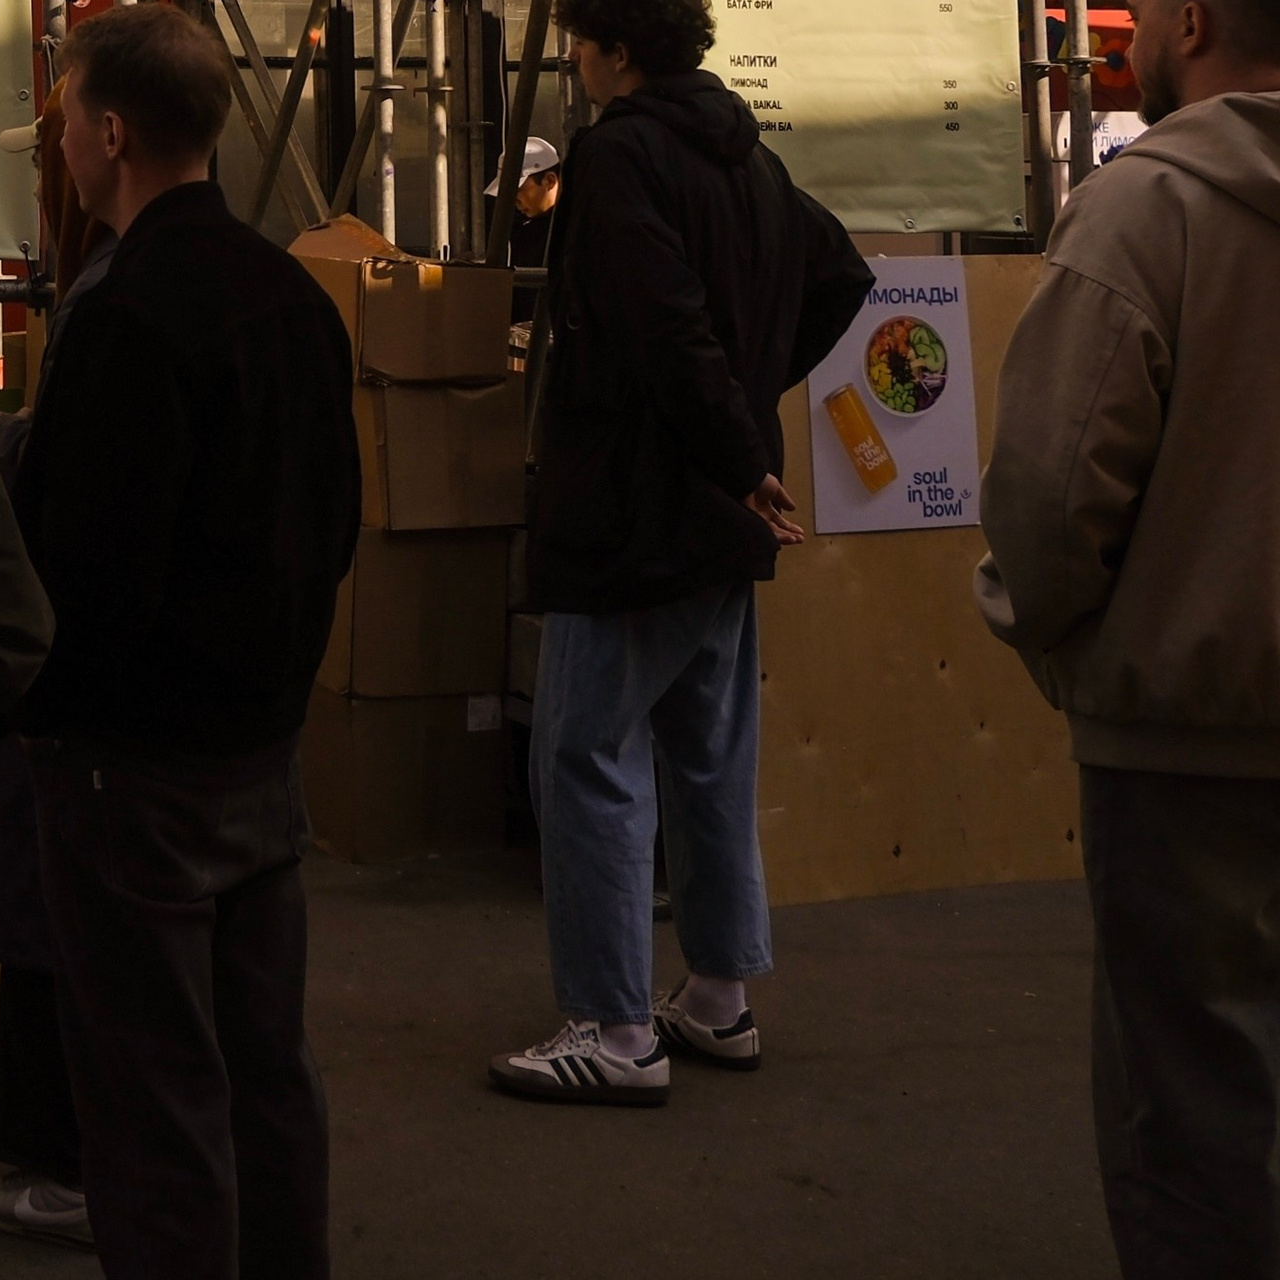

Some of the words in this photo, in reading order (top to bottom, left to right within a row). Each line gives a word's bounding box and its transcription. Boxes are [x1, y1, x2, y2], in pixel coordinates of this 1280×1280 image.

[753, 0, 773, 11] ФРИ
[938, 3, 953, 14] 550
[729, 54, 778, 68] НАПИТКИ
[729, 77, 769, 89] ЛИМОНАД
[942, 79, 958, 90] 350
[753, 100, 783, 110] BAIKAL
[943, 100, 959, 111] 300
[777, 121, 794, 132] Б/А
[944, 121, 960, 132] 450
[913, 467, 948, 486] soul
[907, 485, 923, 503] in
[926, 485, 955, 501] the
[922, 499, 963, 518] bowl
